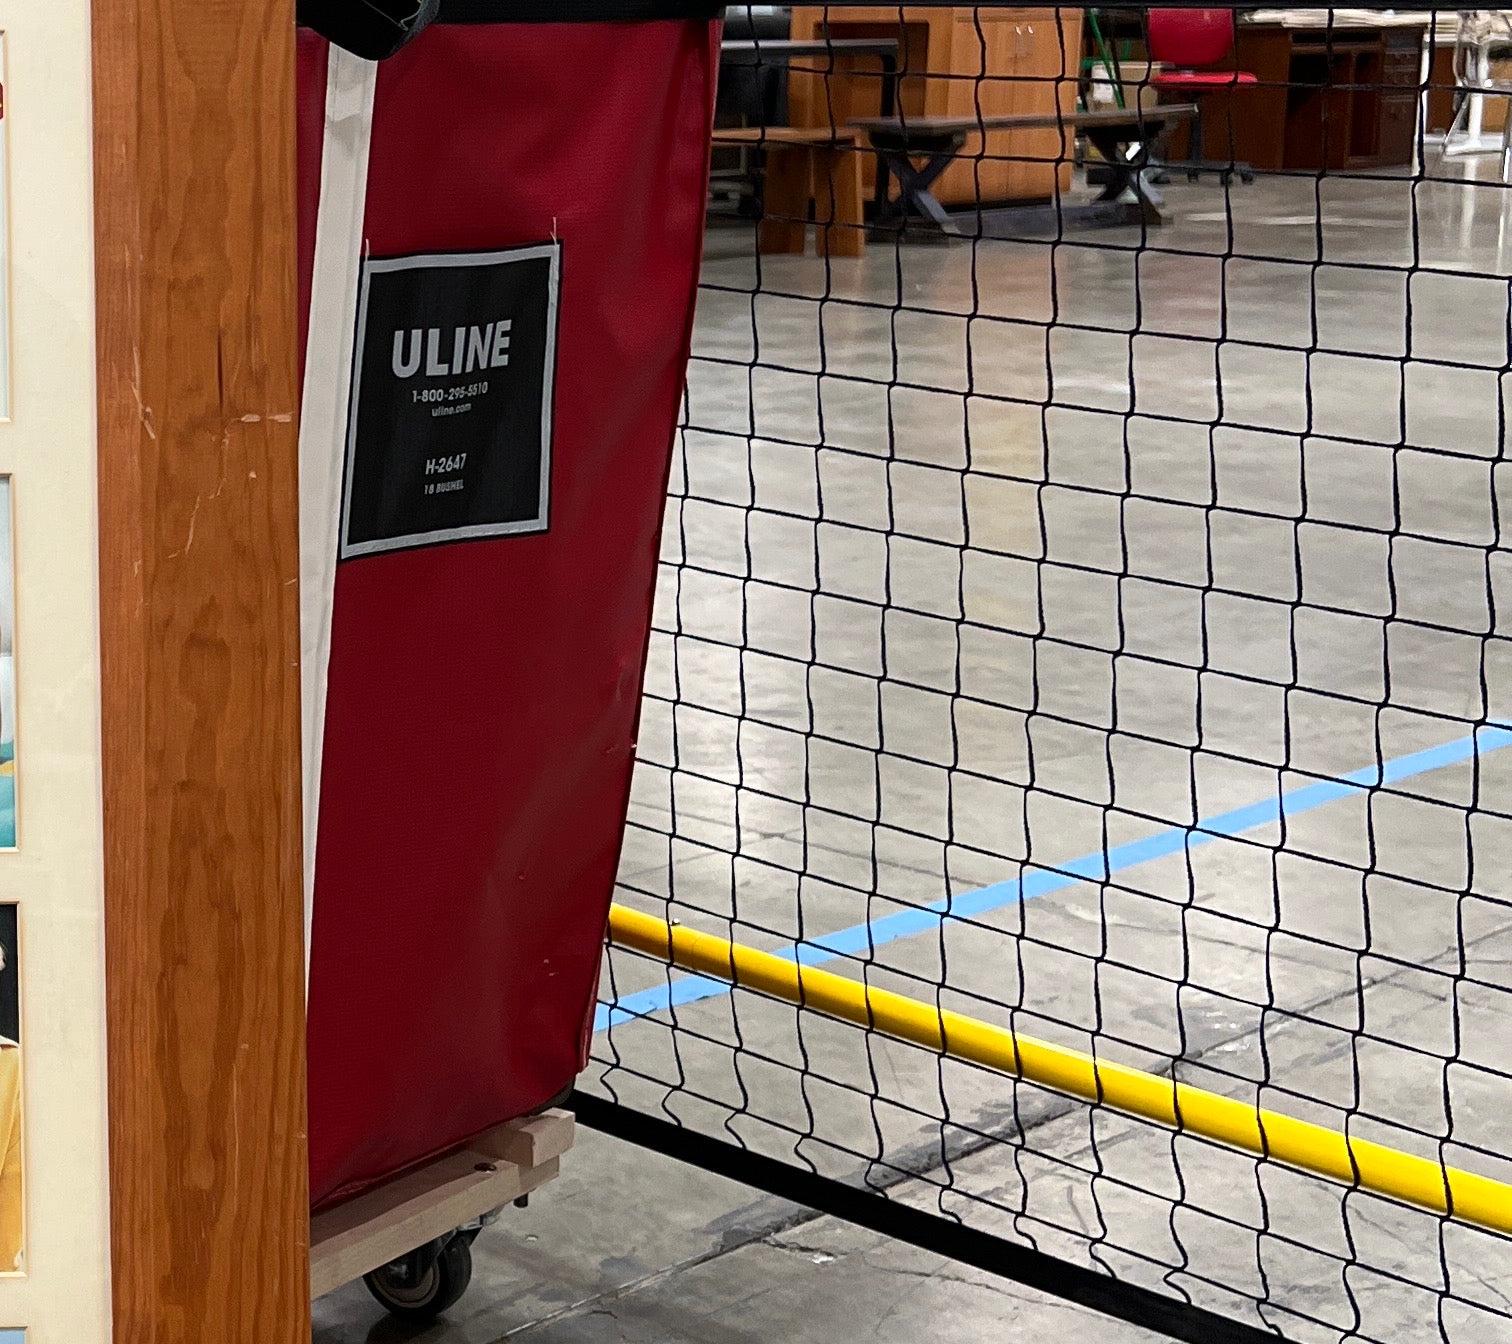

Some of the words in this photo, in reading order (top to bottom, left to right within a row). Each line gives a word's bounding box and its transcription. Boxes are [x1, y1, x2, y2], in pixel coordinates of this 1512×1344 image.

[392, 320, 512, 378] ULINE
[412, 381, 488, 403] 1-800-295-5510
[425, 452, 467, 475] H-2647
